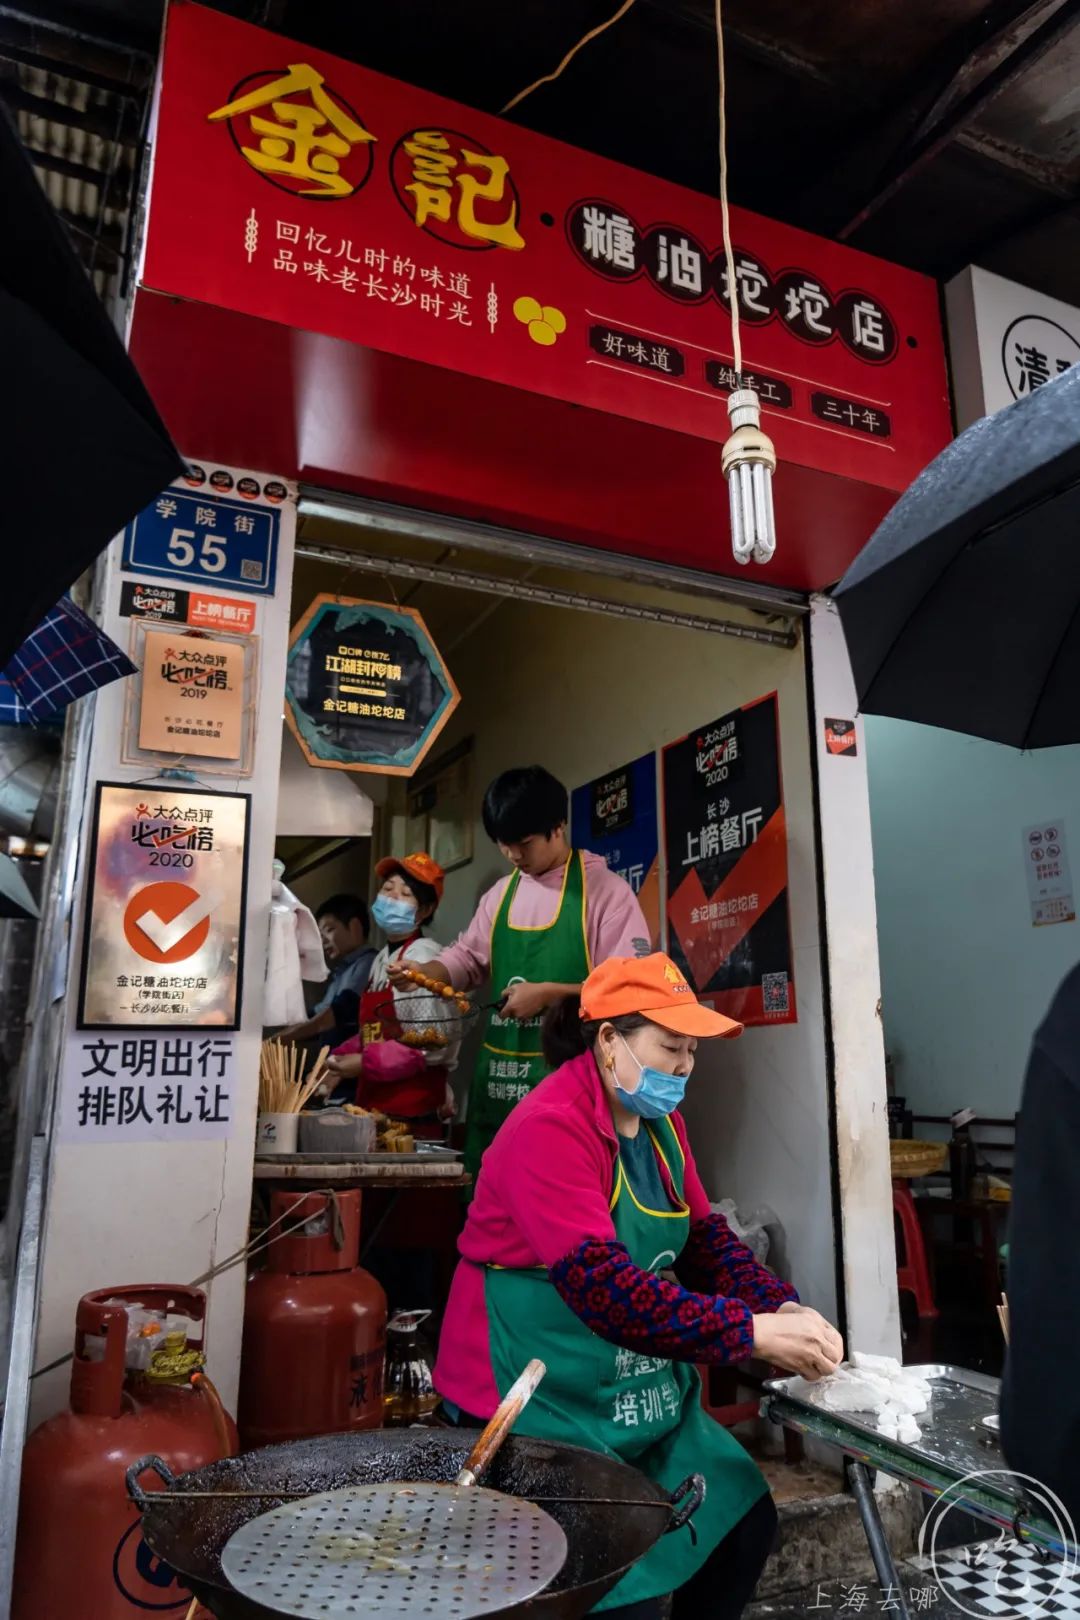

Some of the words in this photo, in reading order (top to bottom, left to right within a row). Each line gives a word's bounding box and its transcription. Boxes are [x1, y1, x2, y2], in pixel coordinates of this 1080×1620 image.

[275, 219, 473, 299] 回忆儿时的味道
[273, 249, 473, 326] 品味老长沙时光
[583, 206, 886, 353] 糖油坨坨店
[602, 332, 672, 373] 好味道
[823, 400, 881, 432] 三十年
[155, 499, 255, 535] 学院街
[166, 528, 227, 573] 55
[179, 650, 228, 667] 大众点评
[161, 662, 228, 690] 必吃榜
[180, 687, 208, 699] 2019
[323, 698, 406, 720] 金记糖油坨坨店
[695, 736, 738, 773] 必吃榜
[705, 766, 729, 787] 2020
[153, 806, 214, 823] 大众点评
[707, 797, 730, 820] 长沙
[132, 821, 214, 851] 必吃榜
[682, 807, 763, 866] 上榜餐厅
[148, 852, 194, 868] 2020
[690, 893, 759, 924] 金记糖油坨坨店
[116, 974, 208, 989] 金记糖油坨坨店
[81, 1038, 232, 1078] 文明出行
[78, 1084, 229, 1127] 排队礼让
